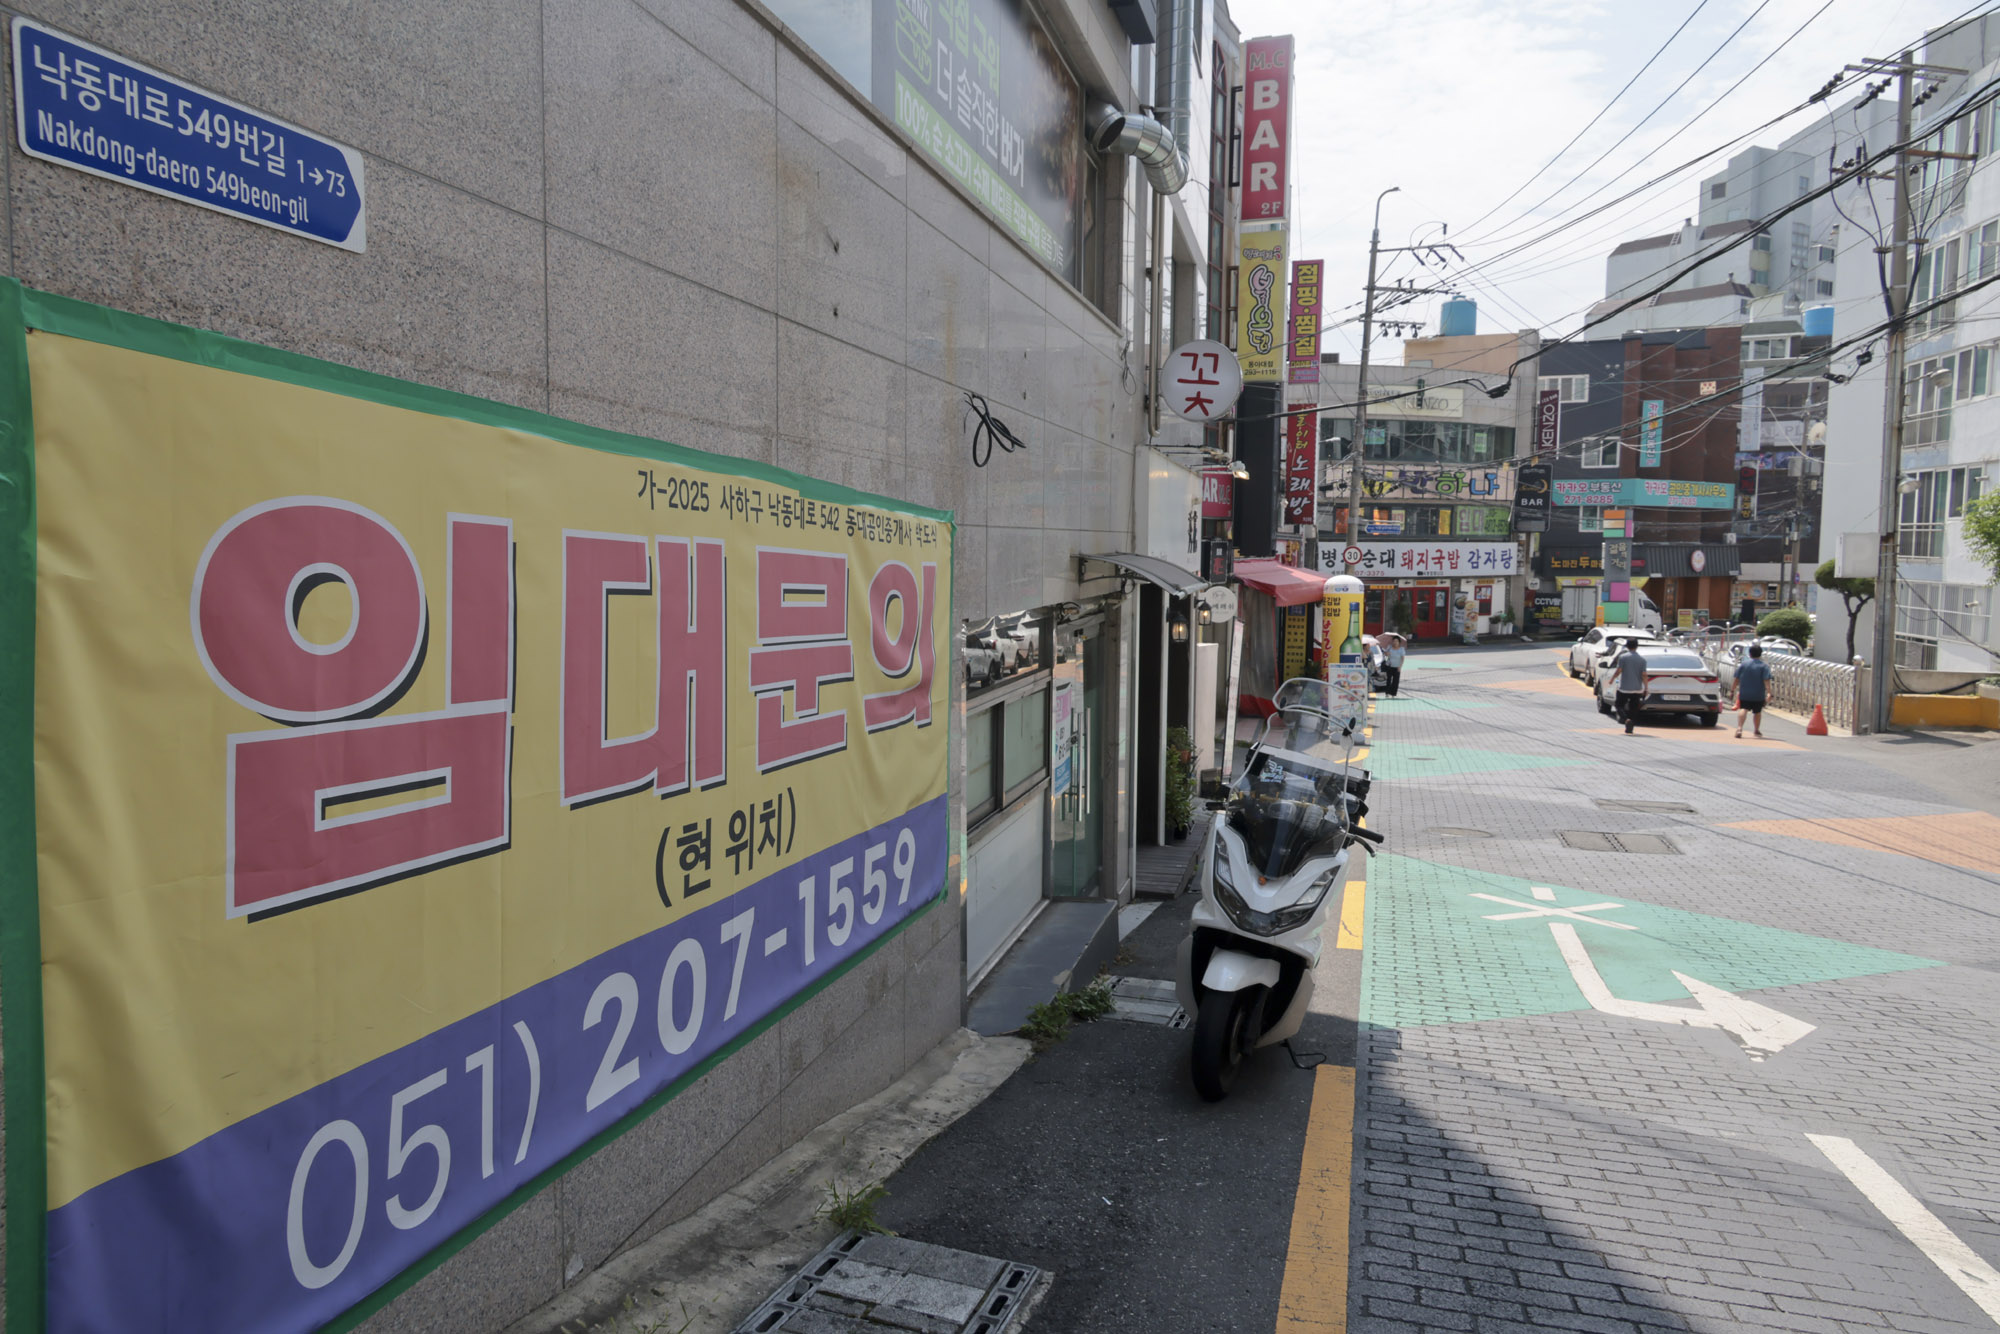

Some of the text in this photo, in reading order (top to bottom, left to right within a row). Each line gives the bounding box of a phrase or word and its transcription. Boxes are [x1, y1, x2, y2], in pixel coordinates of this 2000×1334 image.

[1249, 49, 1286, 71] M.C
[33, 44, 287, 178] 낙동대로549번길
[897, 83, 930, 147] 100%
[937, 39, 1024, 188] 더 솔직한 버거
[1249, 78, 1281, 193] BAR
[37, 109, 309, 225] Nakdong-daero 549beon-gil
[1261, 201, 1282, 215] 2F
[1176, 352, 1220, 416] 꽃
[1404, 396, 1449, 411] KNZO
[1541, 403, 1556, 447] KENZO
[637, 469, 710, 512] 가-2025
[720, 483, 764, 524] 사하구
[768, 492, 817, 531] 낙동대로
[820, 504, 840, 531] 542
[845, 507, 912, 547] 동대공인중개사
[1289, 455, 1311, 517] 노래방
[1521, 498, 1544, 506] BAR
[1555, 482, 1588, 494] 카카오
[1590, 481, 1622, 494] 부동산
[1564, 495, 1613, 504] 271-8285
[1644, 481, 1668, 496] 카카오
[1322, 548, 1513, 570] 병순대 돼지국밥 감자탕
[1347, 551, 1358, 560] 30
[190, 494, 938, 923] 임대문의
[655, 786, 796, 909] (현 위치)
[286, 827, 916, 1289] 051) 207-1559
